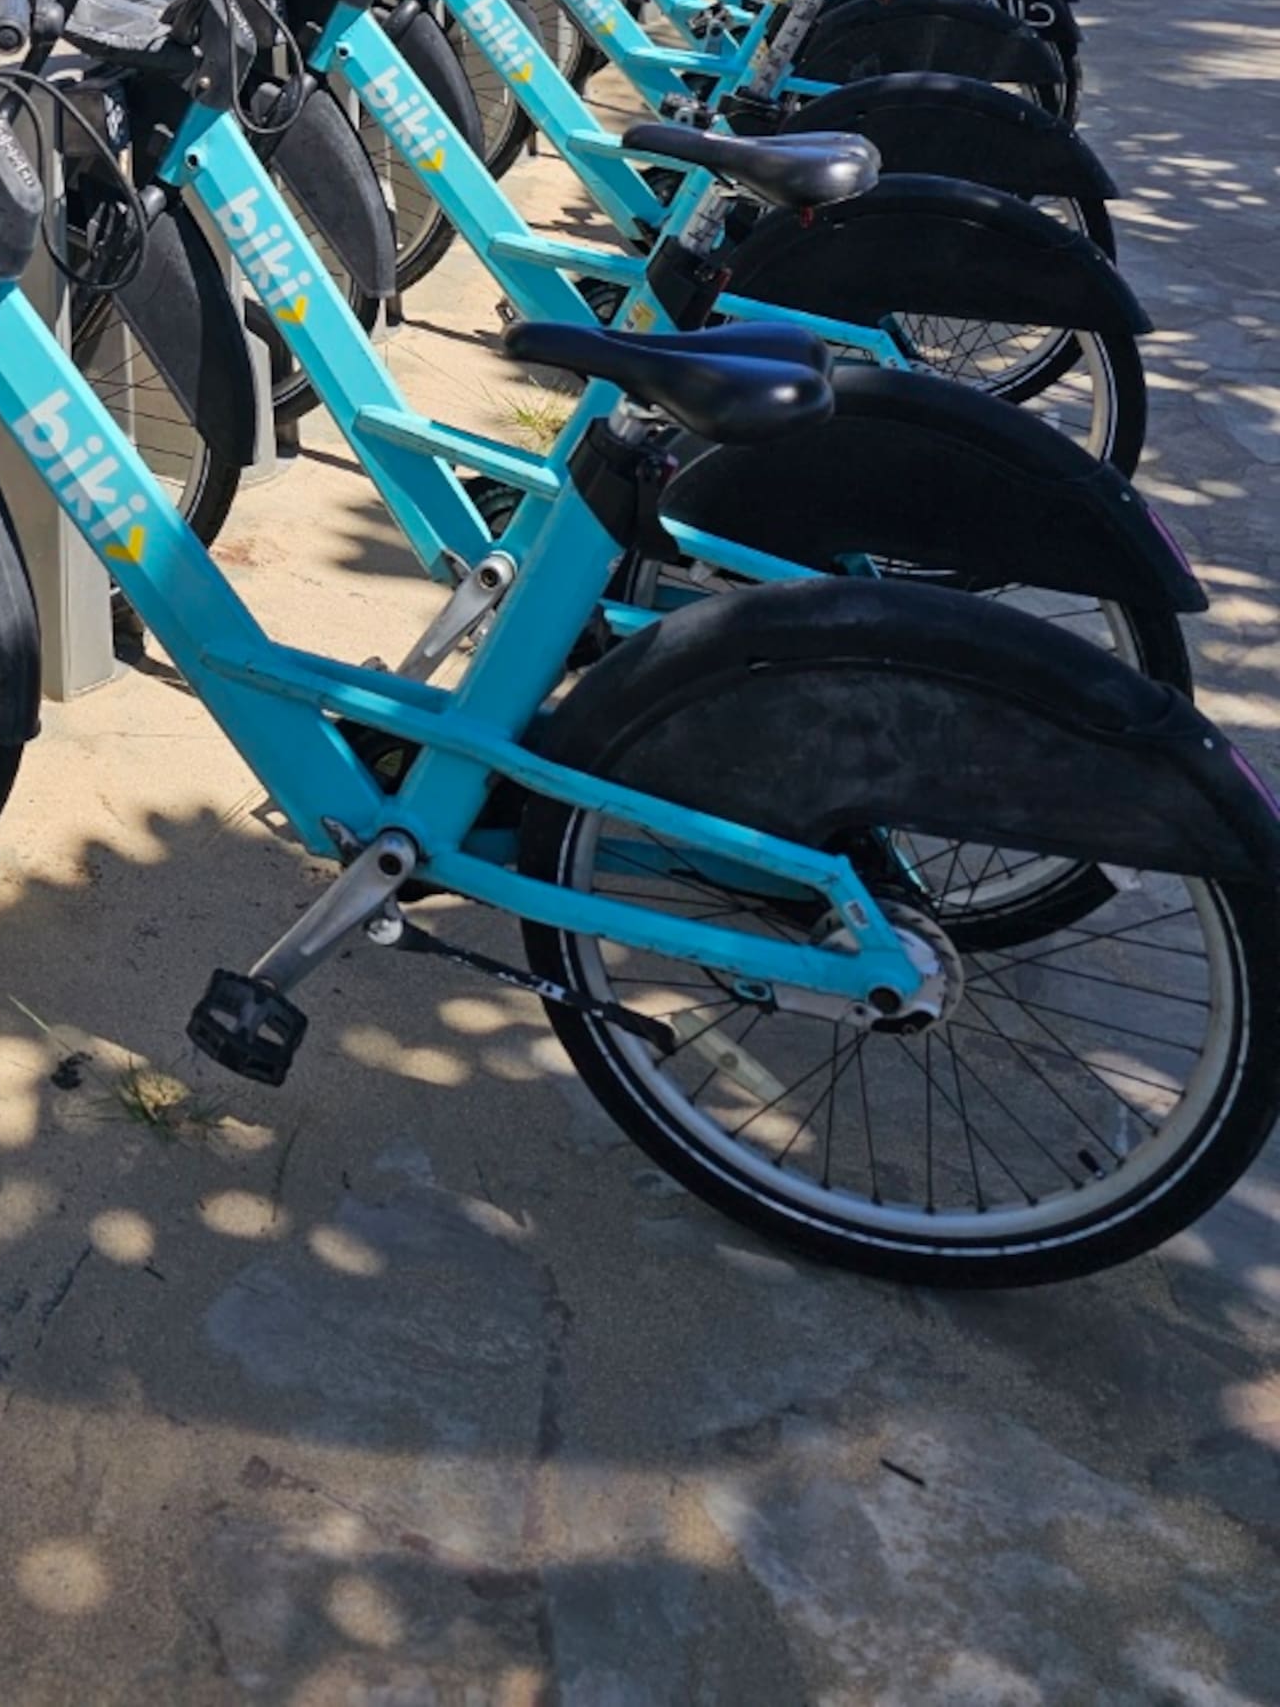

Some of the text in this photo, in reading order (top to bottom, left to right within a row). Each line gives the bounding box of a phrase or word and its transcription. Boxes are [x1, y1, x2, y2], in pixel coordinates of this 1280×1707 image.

[362, 66, 447, 160] biki
[214, 186, 312, 306] biki
[11, 389, 148, 541] biki
